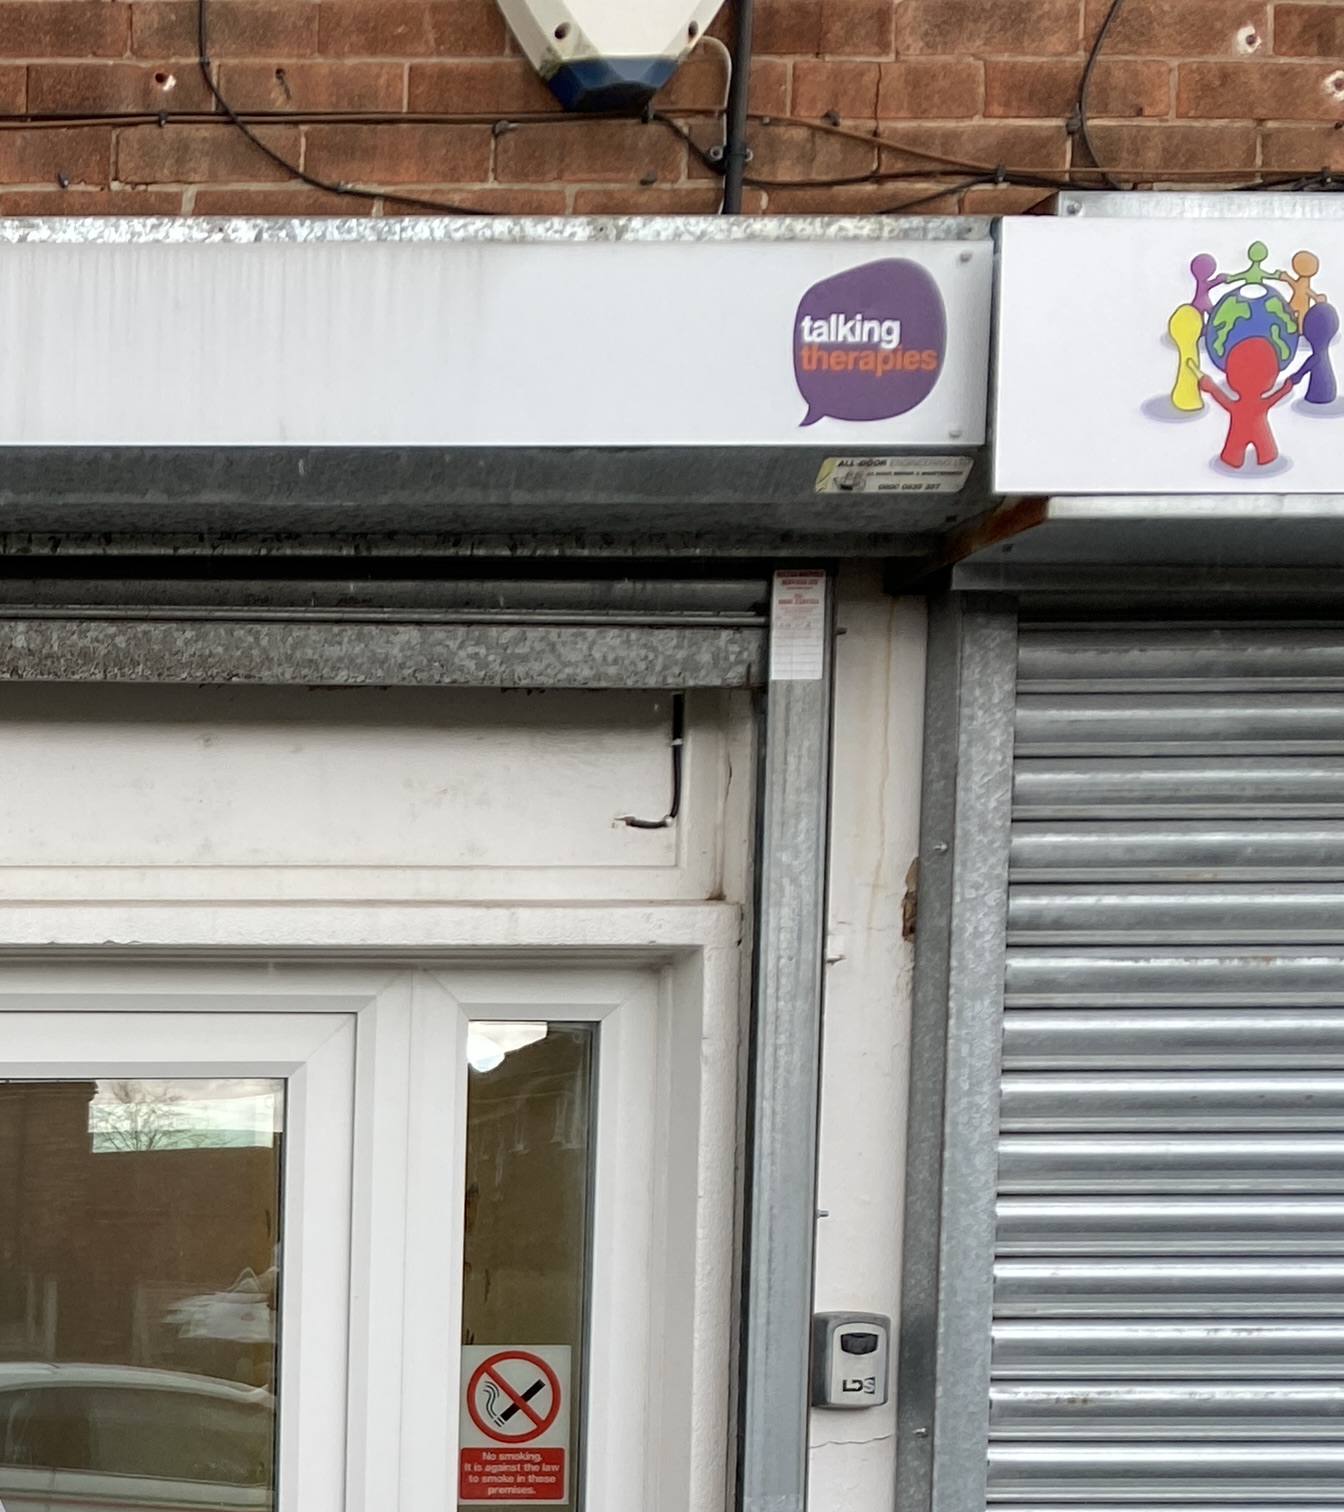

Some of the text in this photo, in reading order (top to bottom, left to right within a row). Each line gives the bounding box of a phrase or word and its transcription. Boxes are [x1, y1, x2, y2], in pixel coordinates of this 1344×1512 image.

[801, 314, 900, 349] talking
[800, 345, 939, 376] therapies
[482, 1452, 496, 1460] No
[464, 1463, 560, 1473] It is against the law
[468, 1474, 556, 1483] to smoke in these
